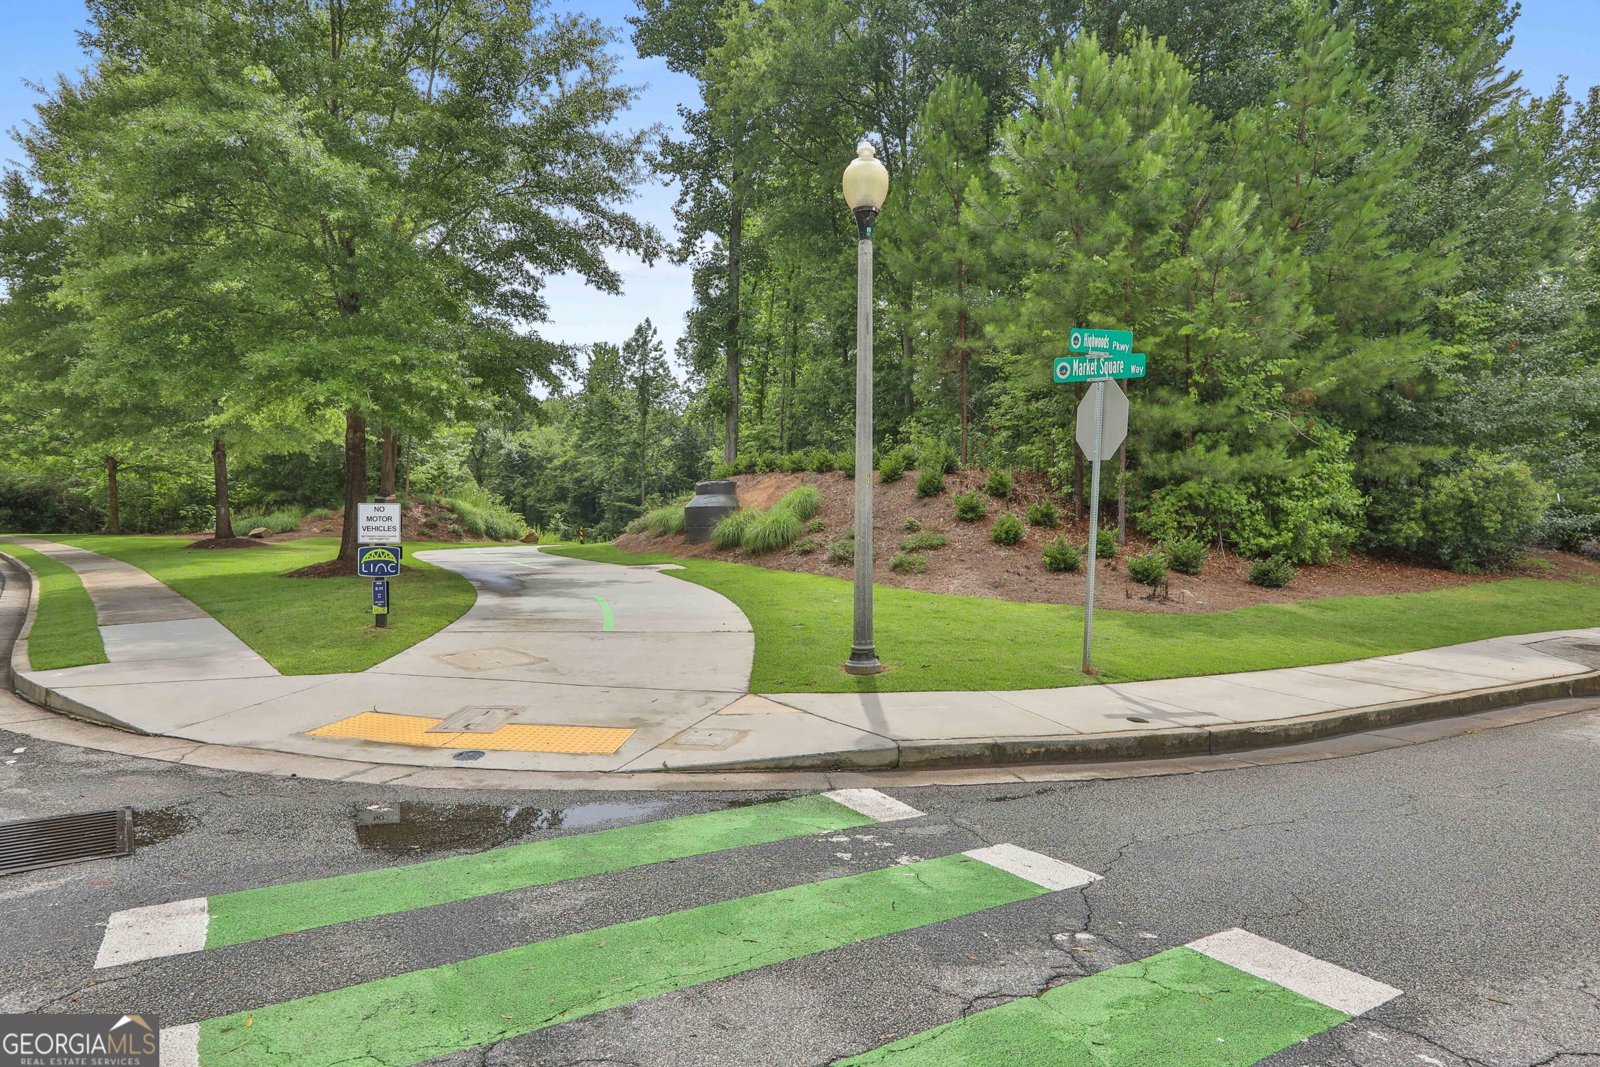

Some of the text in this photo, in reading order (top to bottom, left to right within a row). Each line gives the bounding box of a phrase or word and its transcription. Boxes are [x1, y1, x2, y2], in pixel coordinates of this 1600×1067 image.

[1112, 341, 1130, 354] Pkwy
[1072, 358, 1144, 378] Market Square Way
